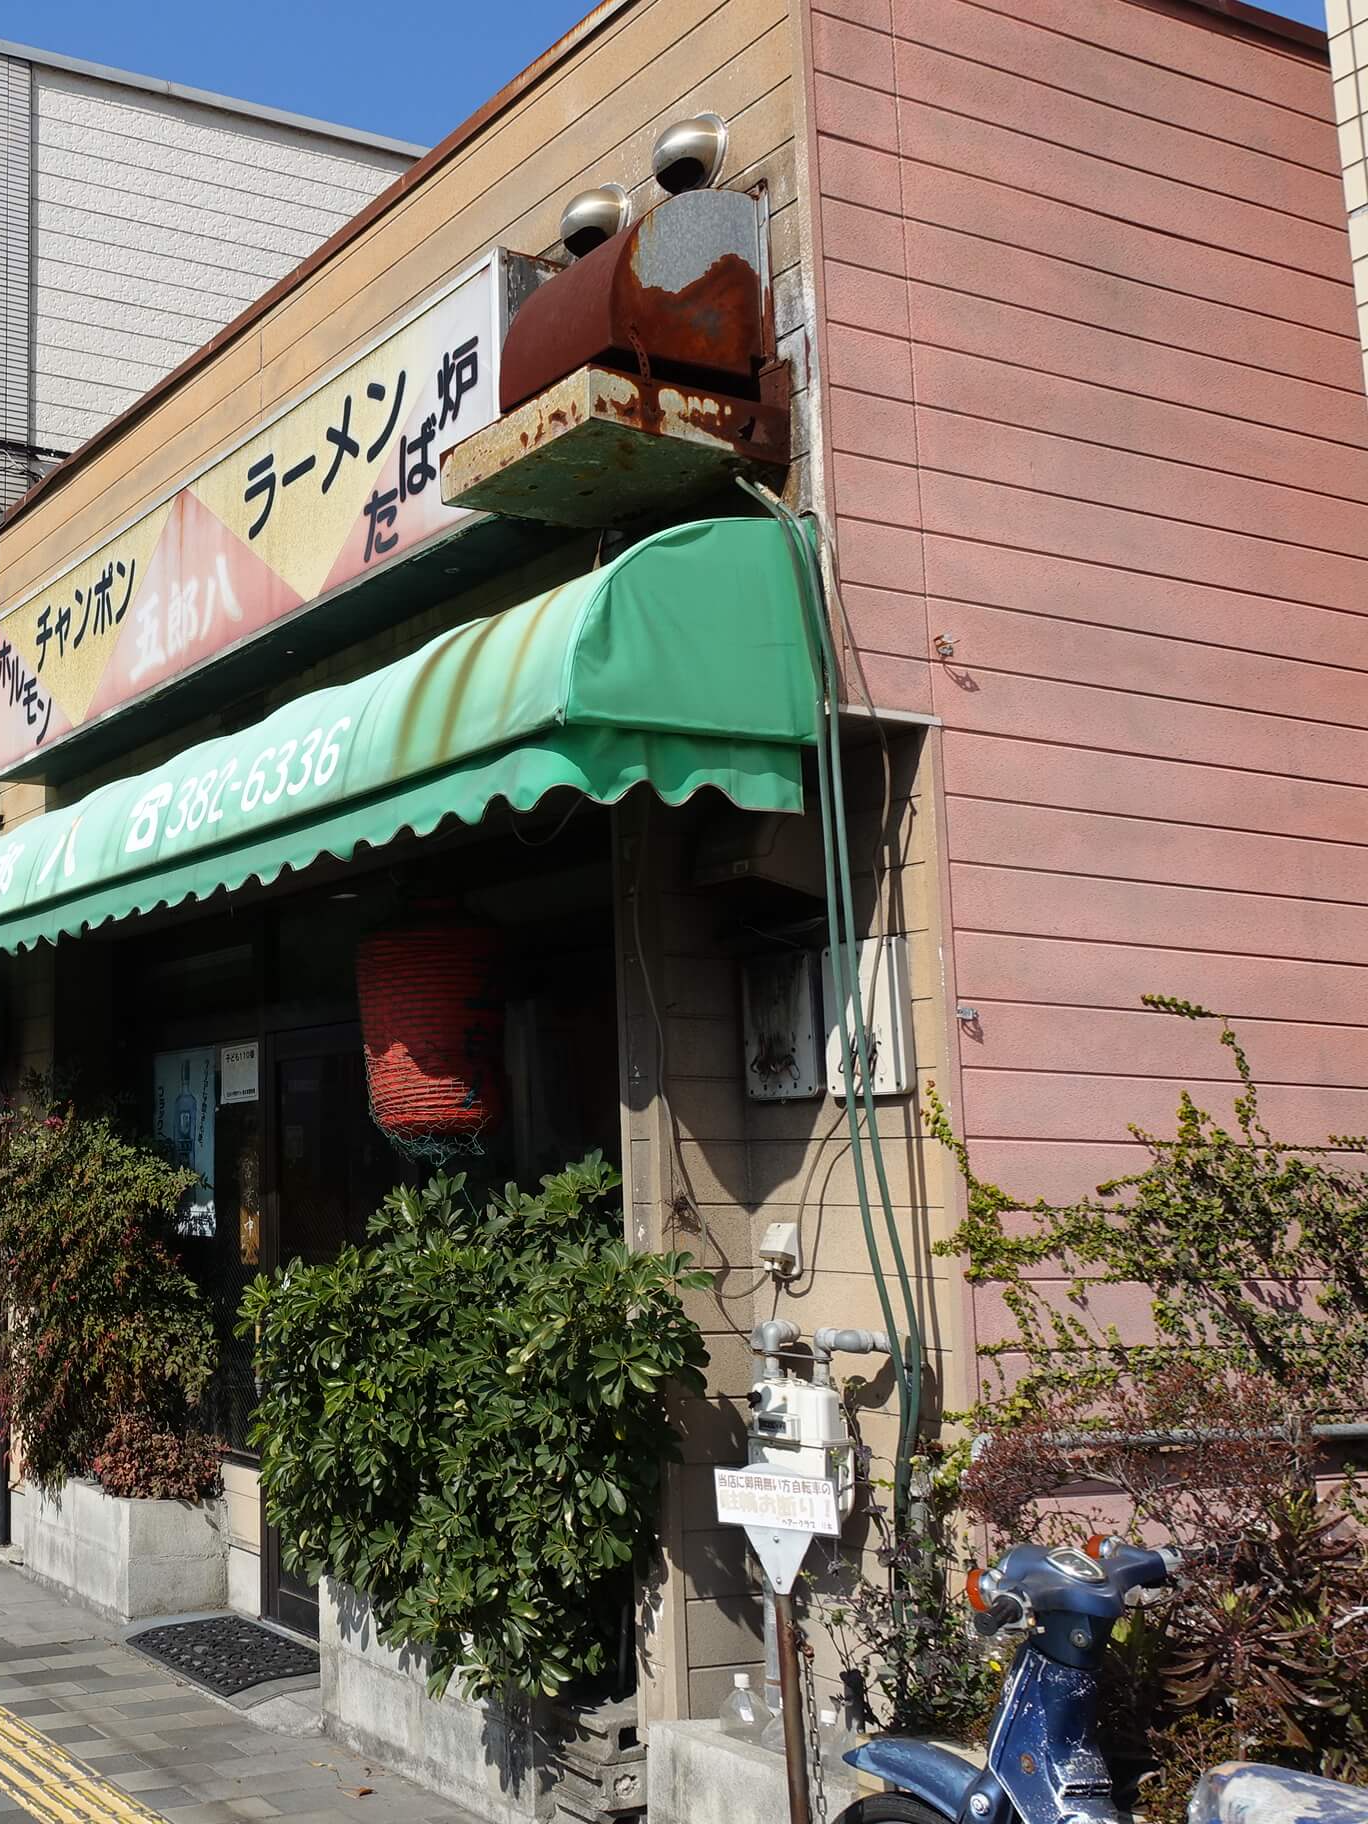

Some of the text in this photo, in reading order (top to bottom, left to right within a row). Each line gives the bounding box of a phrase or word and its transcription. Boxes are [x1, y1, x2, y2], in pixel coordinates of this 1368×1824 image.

[244, 370, 406, 540] ラーメン
[36, 558, 135, 673] チャンポン
[129, 552, 244, 682] 五郎八
[166, 716, 351, 839] 382-6336
